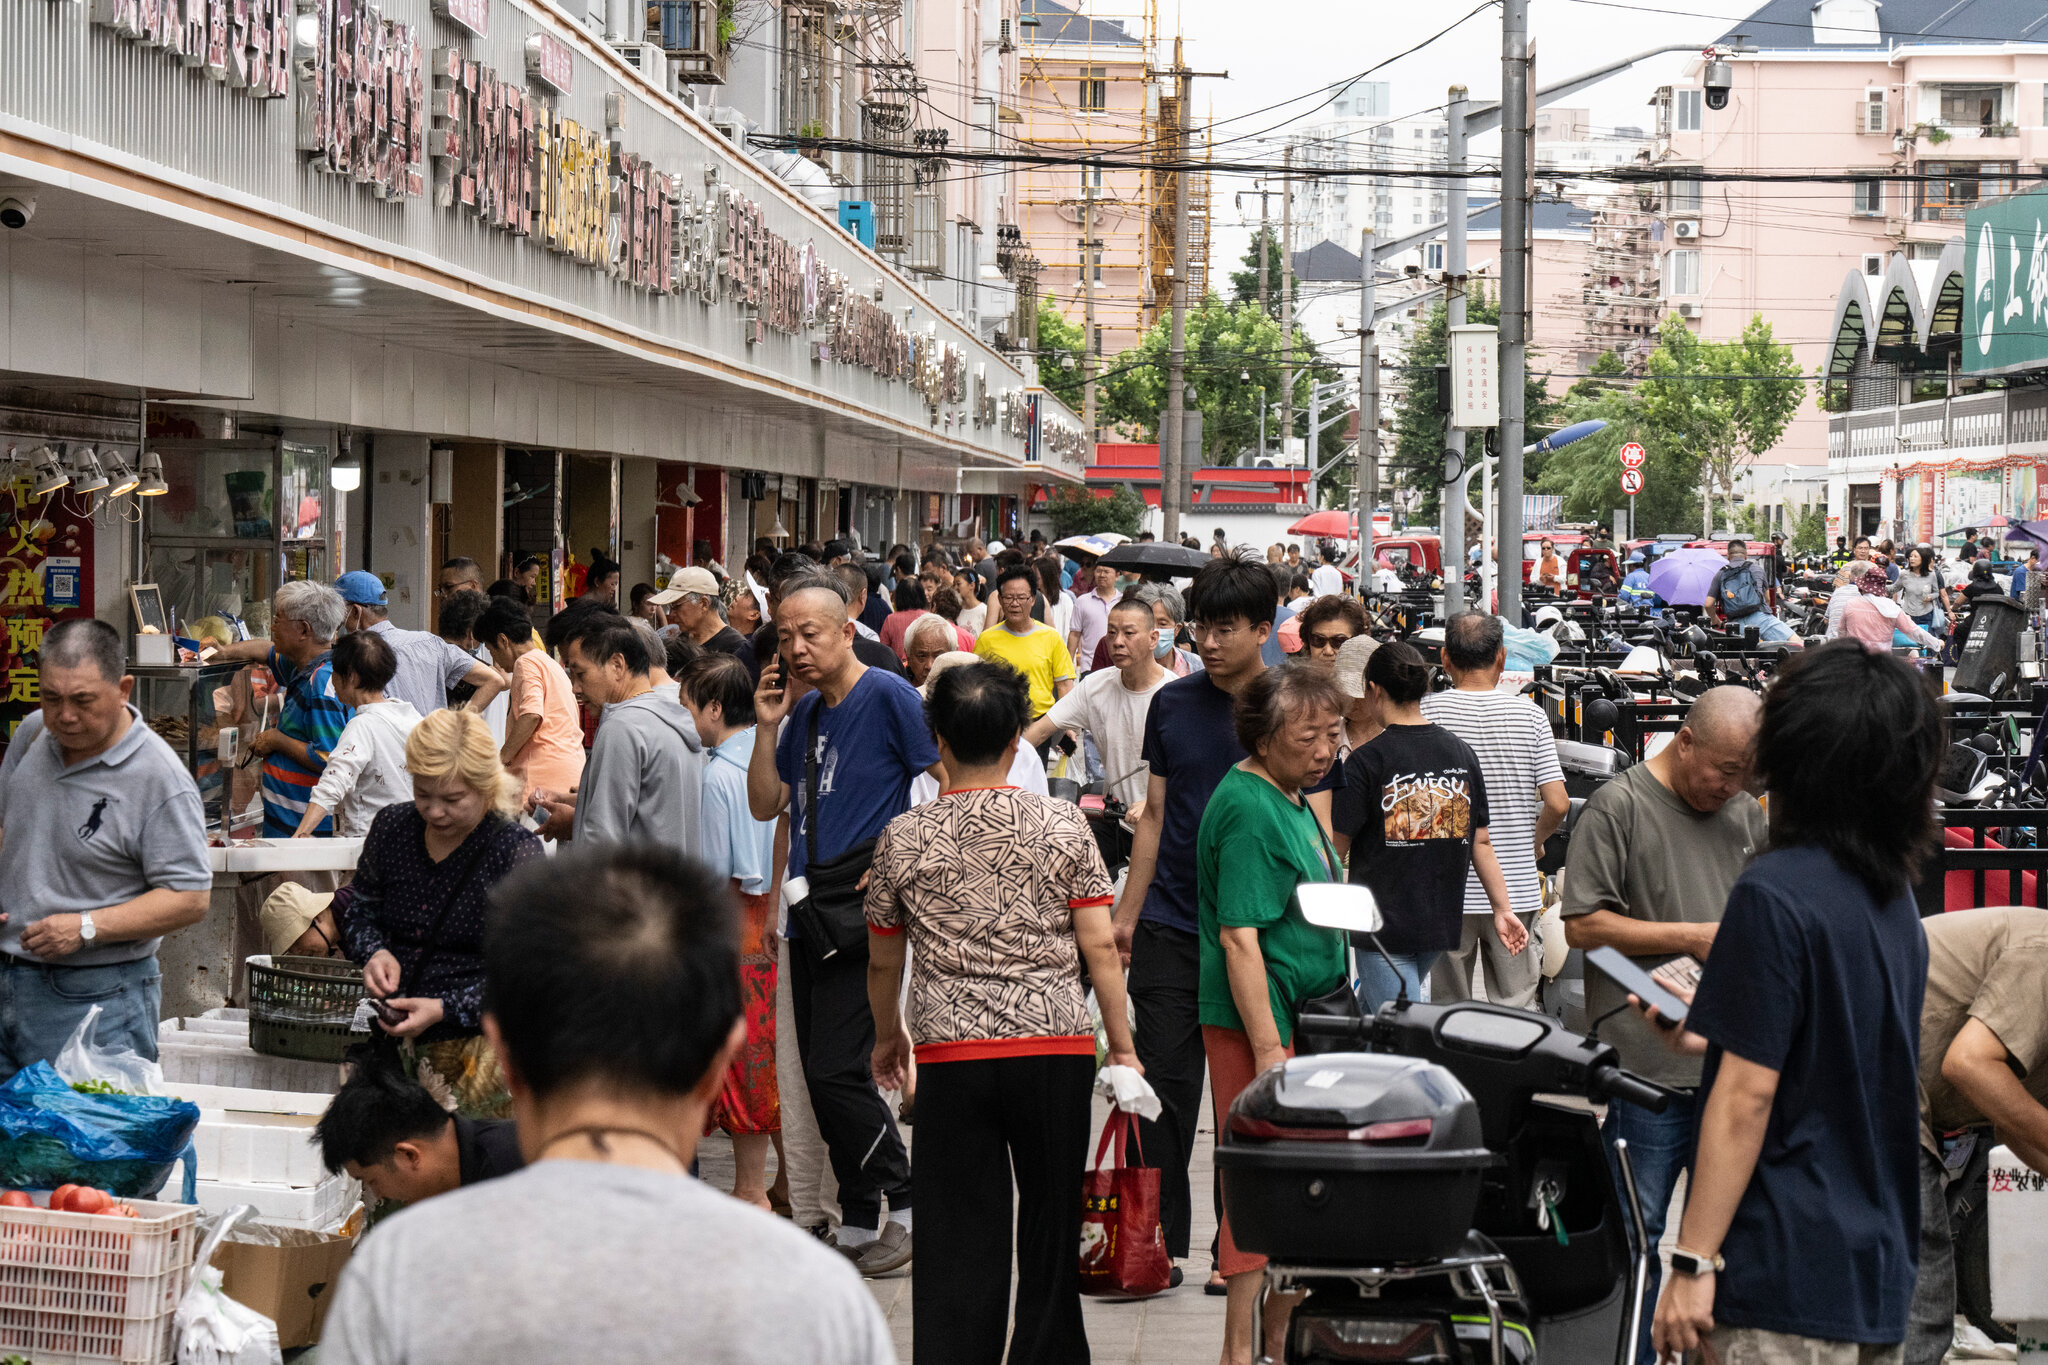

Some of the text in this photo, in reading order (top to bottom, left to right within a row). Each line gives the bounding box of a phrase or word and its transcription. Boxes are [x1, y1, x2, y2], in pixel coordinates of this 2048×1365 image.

[1480, 345, 1488, 410] 保障交通安全
[1624, 446, 1642, 465] 停
[6, 474, 46, 741] 节火热预定
